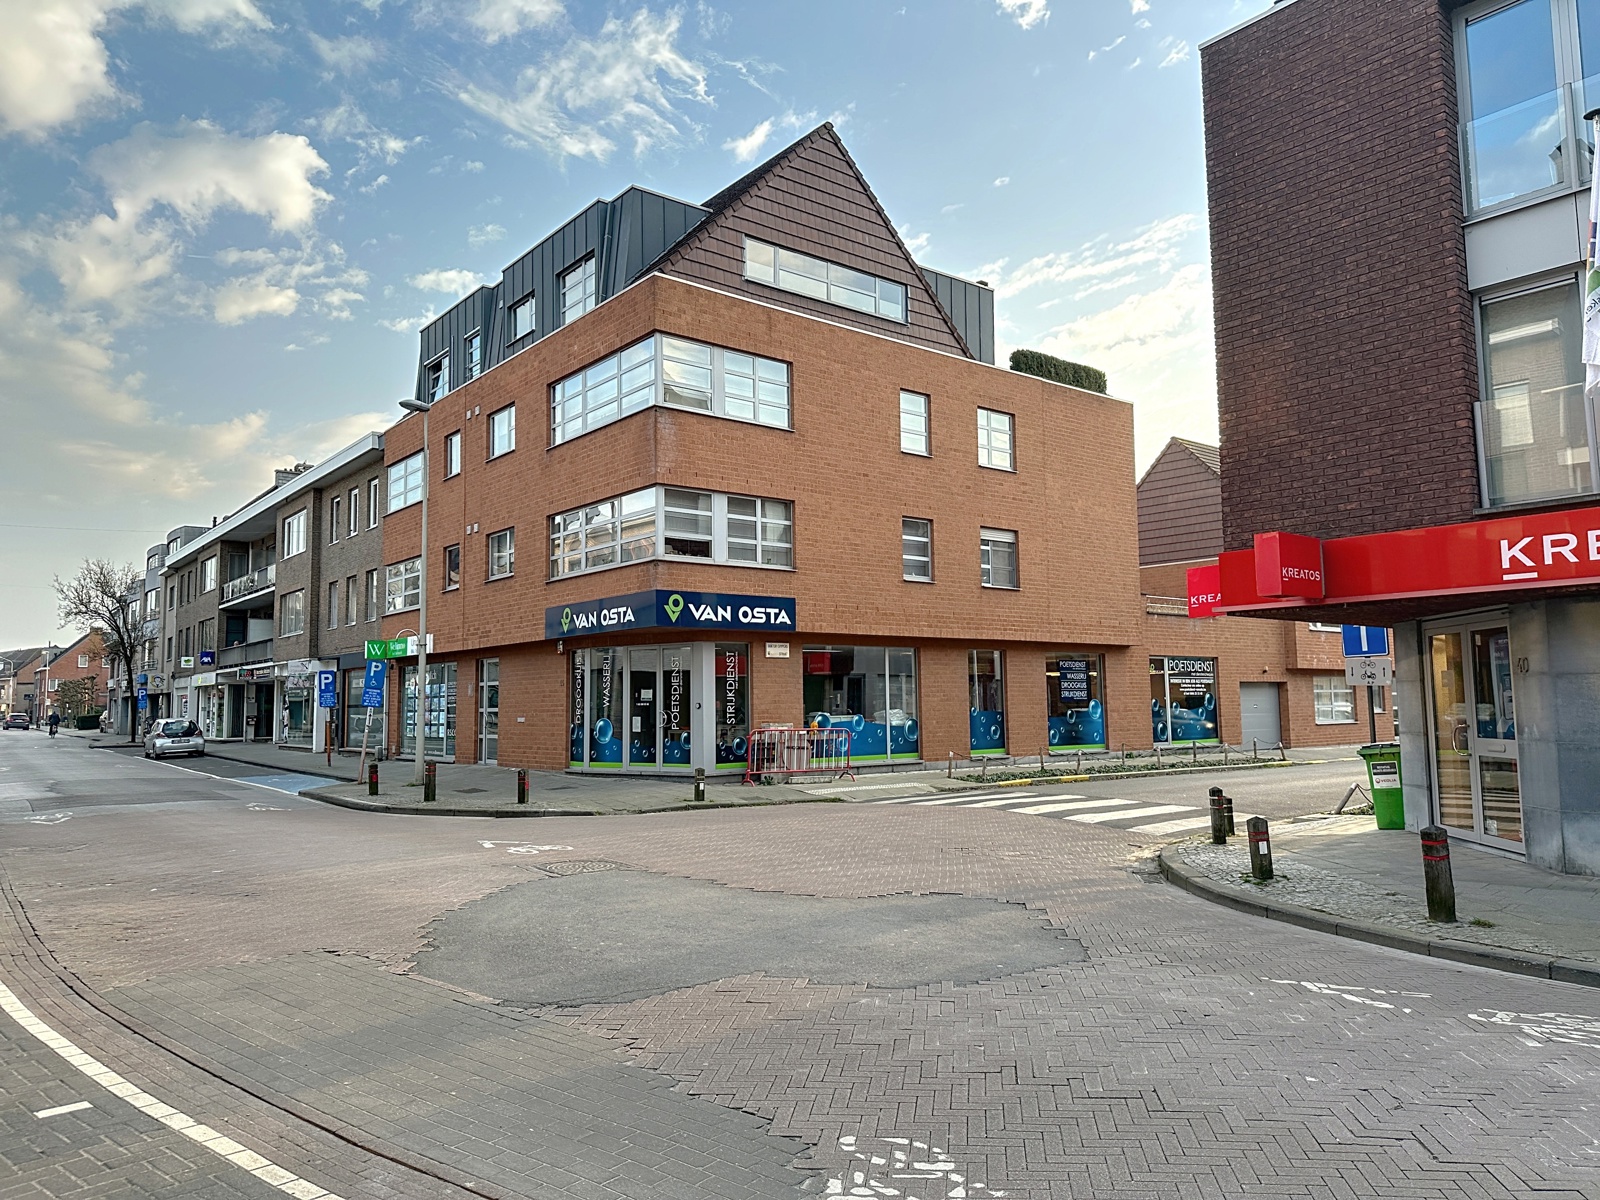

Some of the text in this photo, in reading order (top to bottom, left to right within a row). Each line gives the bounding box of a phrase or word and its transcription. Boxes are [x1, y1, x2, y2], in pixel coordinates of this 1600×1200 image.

[1282, 566, 1321, 581] KREATOS
[572, 606, 636, 629] VAN OSTA
[688, 603, 792, 625] VAN OSTA
[368, 643, 385, 656] W
[370, 661, 382, 677] P
[1059, 660, 1086, 668] POETSDIENST
[1168, 659, 1214, 672] POETSDIENST
[1517, 657, 1529, 673] 40
[320, 673, 333, 690] P
[602, 655, 611, 708] WASSERIJ
[1066, 672, 1087, 680] WASSERIJ
[671, 655, 680, 730] POETSDIENST
[726, 651, 735, 724] STRIJKDIENST
[1061, 681, 1087, 689] DROOGKUIS
[138, 689, 146, 700] P
[1061, 690, 1087, 698] STRIJKDIENST
